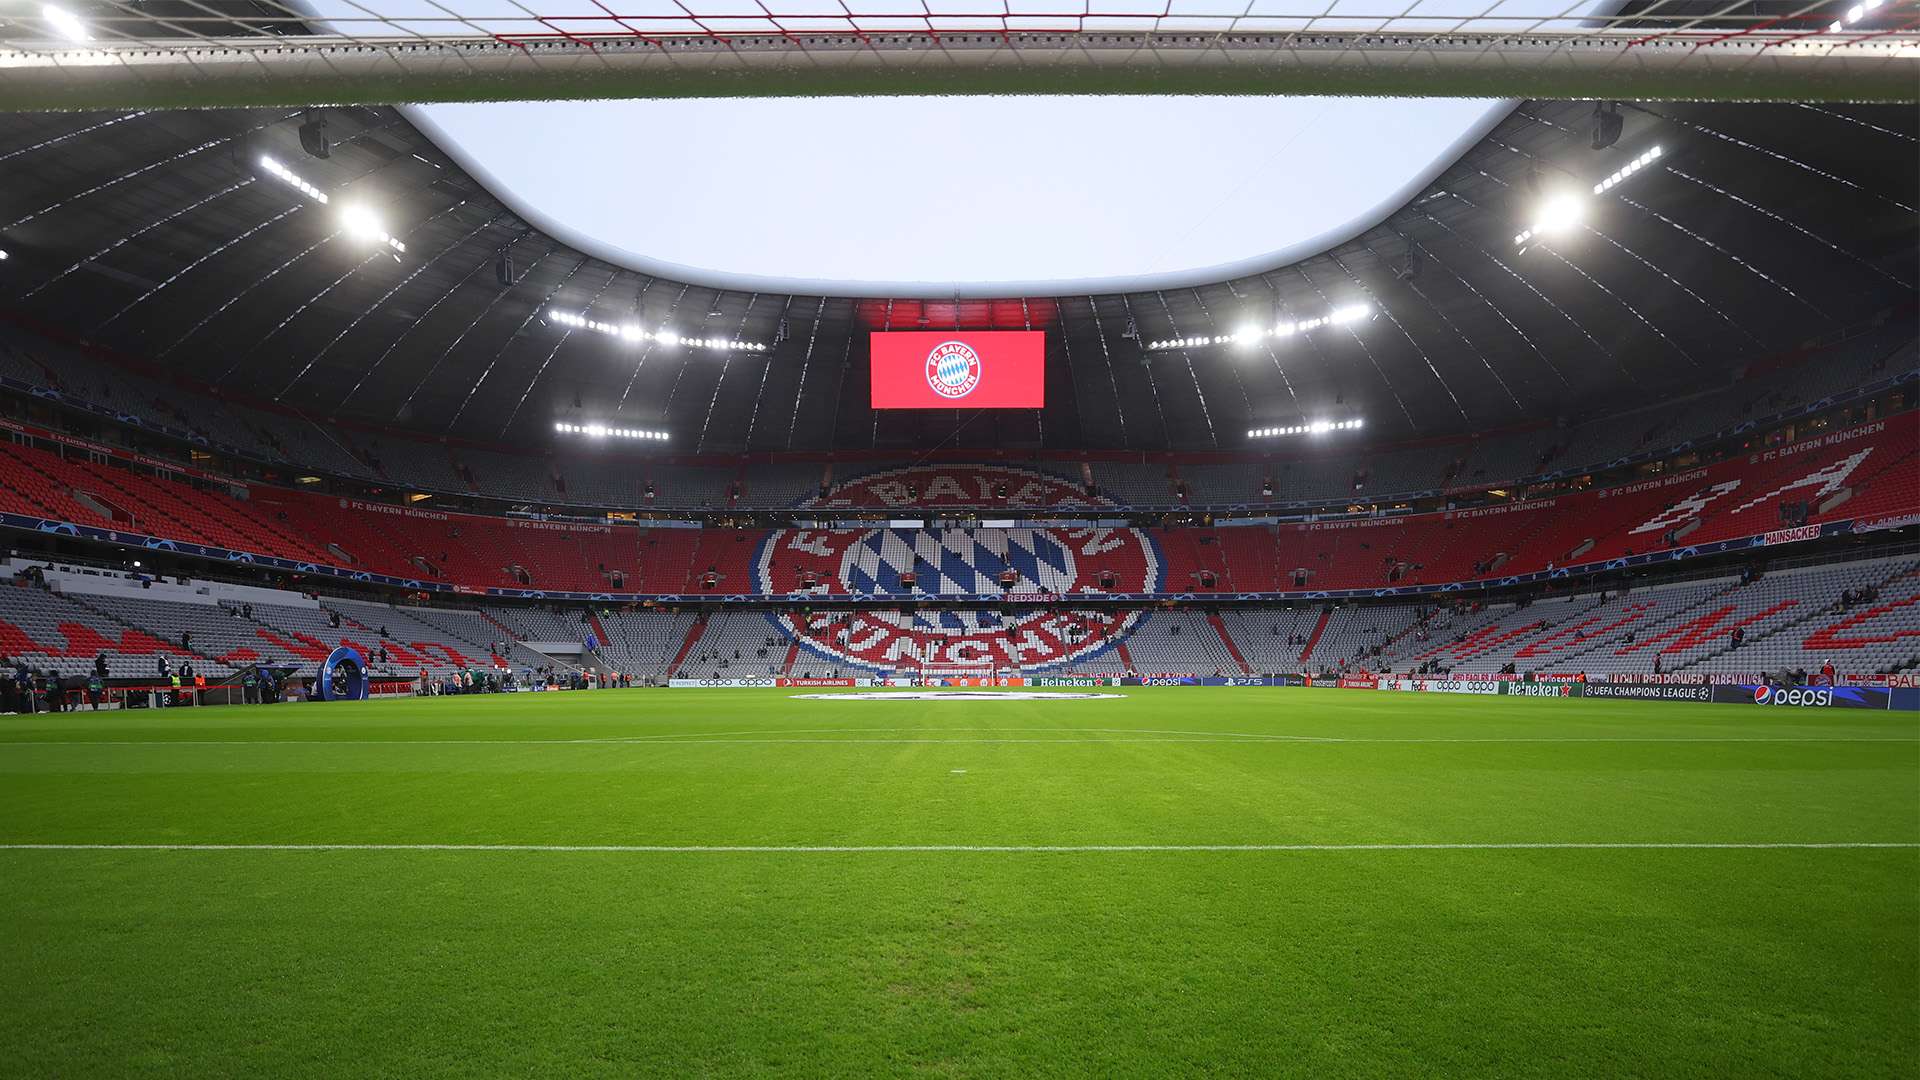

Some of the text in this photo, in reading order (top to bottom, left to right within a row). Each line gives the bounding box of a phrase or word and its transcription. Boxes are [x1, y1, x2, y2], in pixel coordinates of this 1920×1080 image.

[930, 345, 977, 366] FC BAYERN
[1763, 422, 1885, 461] FC BAYERN MÜNCHEN
[1612, 469, 1708, 496] FC BAYERN MÜNCHEN
[352, 501, 448, 521] FC BAYERN MÜNCHEN
[1457, 500, 1556, 519] FC BAYERN MÜNCHEN
[519, 521, 530, 529] FC
[533, 523, 567, 531] BAYERN
[1310, 518, 1403, 531] FC BAYERN MÜNCHEN
[1765, 525, 1821, 545] HAINSACKER
[1007, 594, 1050, 602] REDSIDE
[700, 679, 732, 687] oppo
[739, 679, 772, 687] oppo
[871, 679, 896, 687] FedEx
[1041, 678, 1093, 687] Heineken
[1152, 678, 1180, 687] pepsi
[1643, 674, 1662, 684] RED
[1664, 674, 1704, 685] POWER
[1437, 681, 1461, 692] oppo
[1467, 681, 1494, 694] oppo
[1508, 682, 1559, 697] Heineken
[1594, 687, 1696, 698] UEFA CHAMPIONS LEAGUE
[1774, 687, 1833, 707] pepsi
